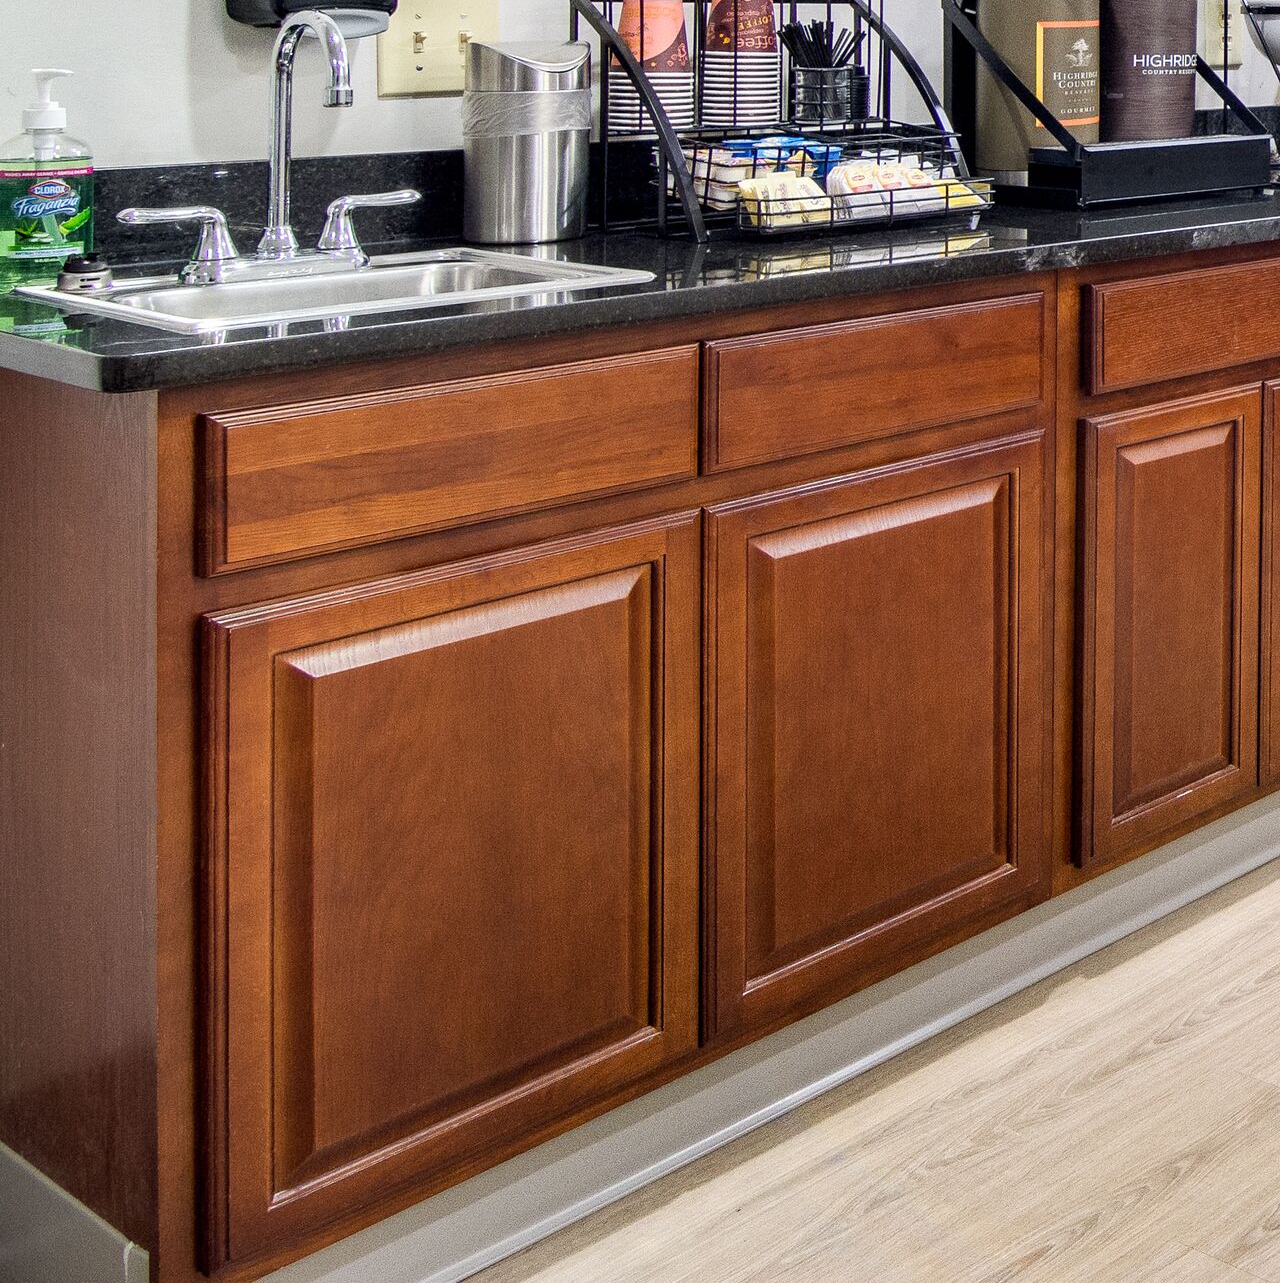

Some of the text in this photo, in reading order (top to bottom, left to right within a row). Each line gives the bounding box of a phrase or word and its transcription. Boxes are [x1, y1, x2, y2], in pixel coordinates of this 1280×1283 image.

[736, 35, 775, 49] offee
[1133, 54, 1197, 67] HIGHRIDG
[34, 185, 66, 195] CLOROX
[13, 196, 80, 218] Fraganzia
